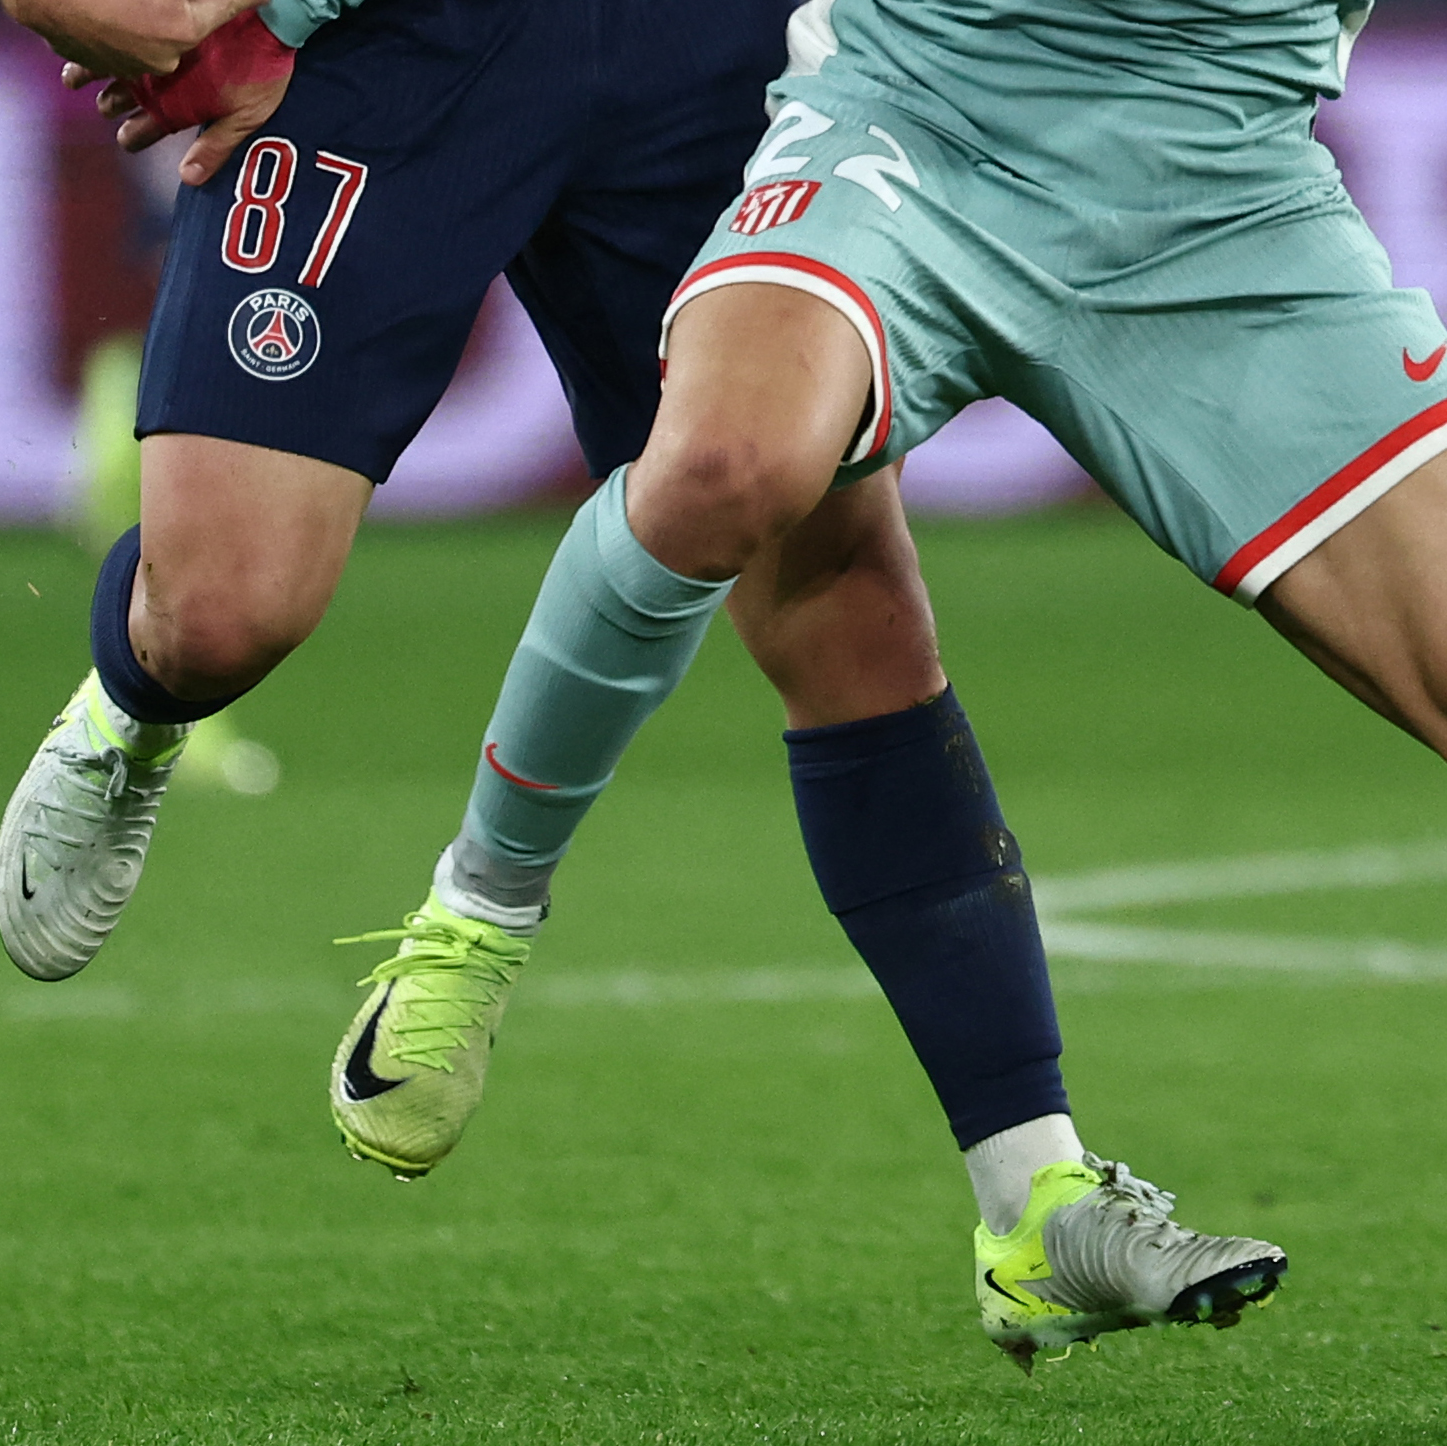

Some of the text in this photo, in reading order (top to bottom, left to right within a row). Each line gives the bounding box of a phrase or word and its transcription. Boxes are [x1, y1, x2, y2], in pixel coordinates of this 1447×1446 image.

[221, 137, 368, 288] 87
[744, 100, 921, 214] 22
[249, 294, 310, 322] PARIS
